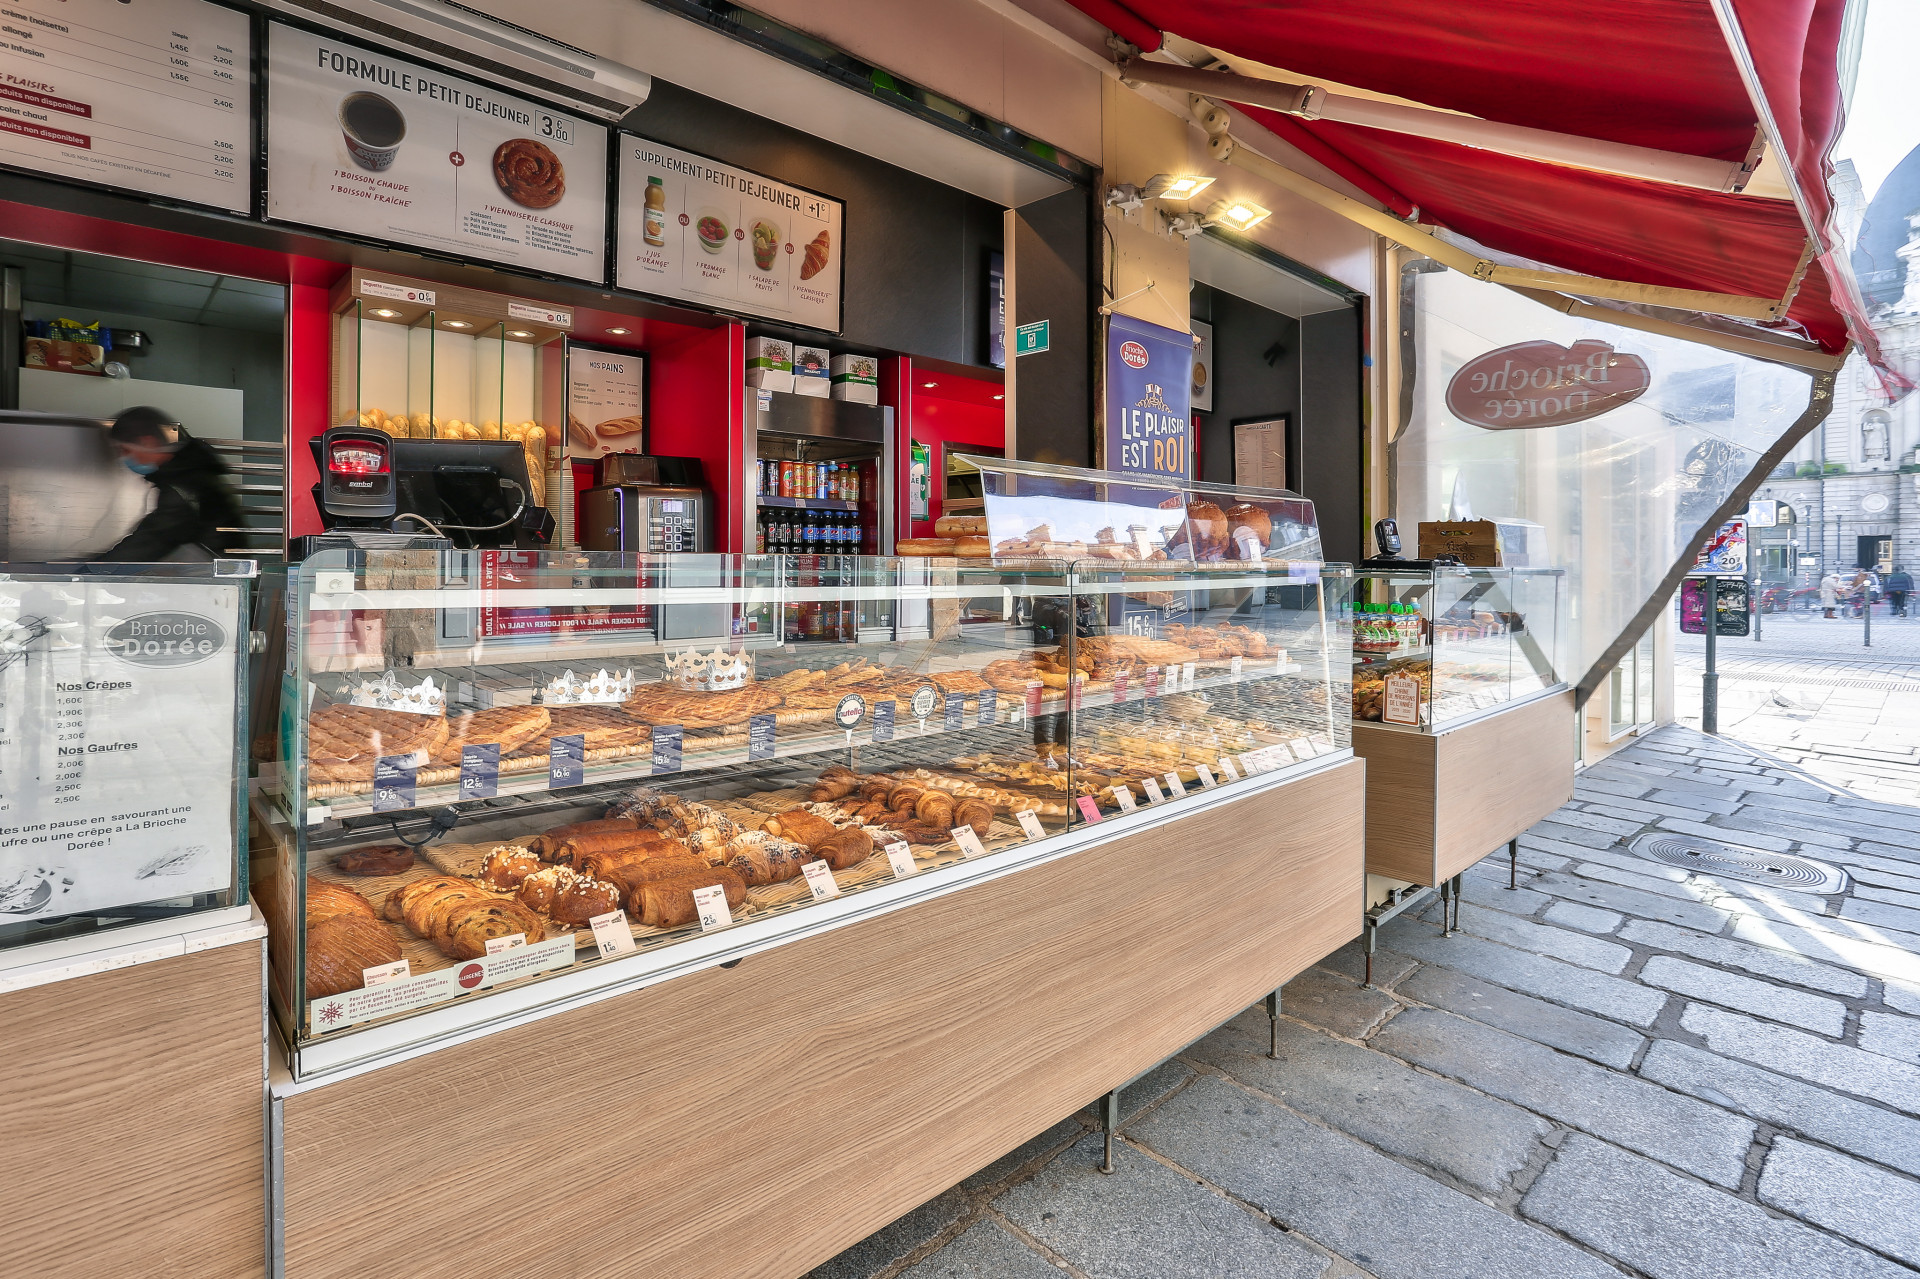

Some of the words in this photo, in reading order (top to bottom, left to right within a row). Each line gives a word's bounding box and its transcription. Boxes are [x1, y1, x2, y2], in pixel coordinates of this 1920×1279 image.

[1, 8, 28, 21] crème
[29, 16, 69, 33] (noisette)
[2, 26, 33, 39] allongé
[11, 44, 45, 58] Infusion
[170, 42, 189, 53] 1,45€
[214, 55, 232, 66] 2,20€
[214, 70, 233, 80] 2,40€
[317, 48, 412, 92] FORMULE
[417, 78, 461, 105] PETIT
[6, 74, 55, 92] PLAISIRS
[41, 98, 85, 113] disponibles
[214, 98, 233, 109] 2,40€
[23, 110, 47, 121] chaud
[40, 130, 84, 144] disponibles
[214, 154, 234, 164] 2,20€
[214, 169, 234, 178] 2,20€
[706, 168, 736, 189] PETIT
[341, 172, 375, 184] BOISSON
[377, 180, 410, 192] CHAUDE
[338, 186, 371, 198] BOISSON
[490, 206, 539, 222] VIENNOISERIE
[540, 218, 574, 231] CLASSIQUE
[700, 262, 726, 274] FROMAGE
[702, 271, 720, 280] BLANC
[752, 275, 771, 286] SALADE
[755, 282, 773, 291] FRUITS
[1126, 344, 1144, 356] Brioche
[1124, 352, 1146, 365] Dorée
[602, 363, 624, 374] PAINS
[1122, 408, 1140, 440] LE
[1145, 412, 1184, 438] PLAISIR
[1122, 441, 1149, 468] EST
[1154, 435, 1184, 474] ROI
[130, 620, 206, 636] Brioche
[122, 638, 213, 656] Dorée
[56, 682, 82, 691] Nos
[86, 681, 132, 690] Crêpes
[838, 707, 862, 718] nutella
[59, 733, 84, 741] 2,30€
[58, 746, 84, 755] Nos
[88, 742, 138, 753] Gaufres
[56, 772, 81, 780] 2,00€
[56, 784, 81, 792] 2,50€
[55, 796, 80, 804] 2,50€
[23, 823, 46, 832] une
[50, 819, 87, 830] pause
[112, 808, 169, 822] savourant
[172, 805, 192, 814] une
[51, 832, 74, 841] une
[77, 827, 112, 838] crêpe
[144, 816, 187, 828] Brioche
[67, 839, 104, 850] Dorée
[363, 990, 384, 1000] garantir
